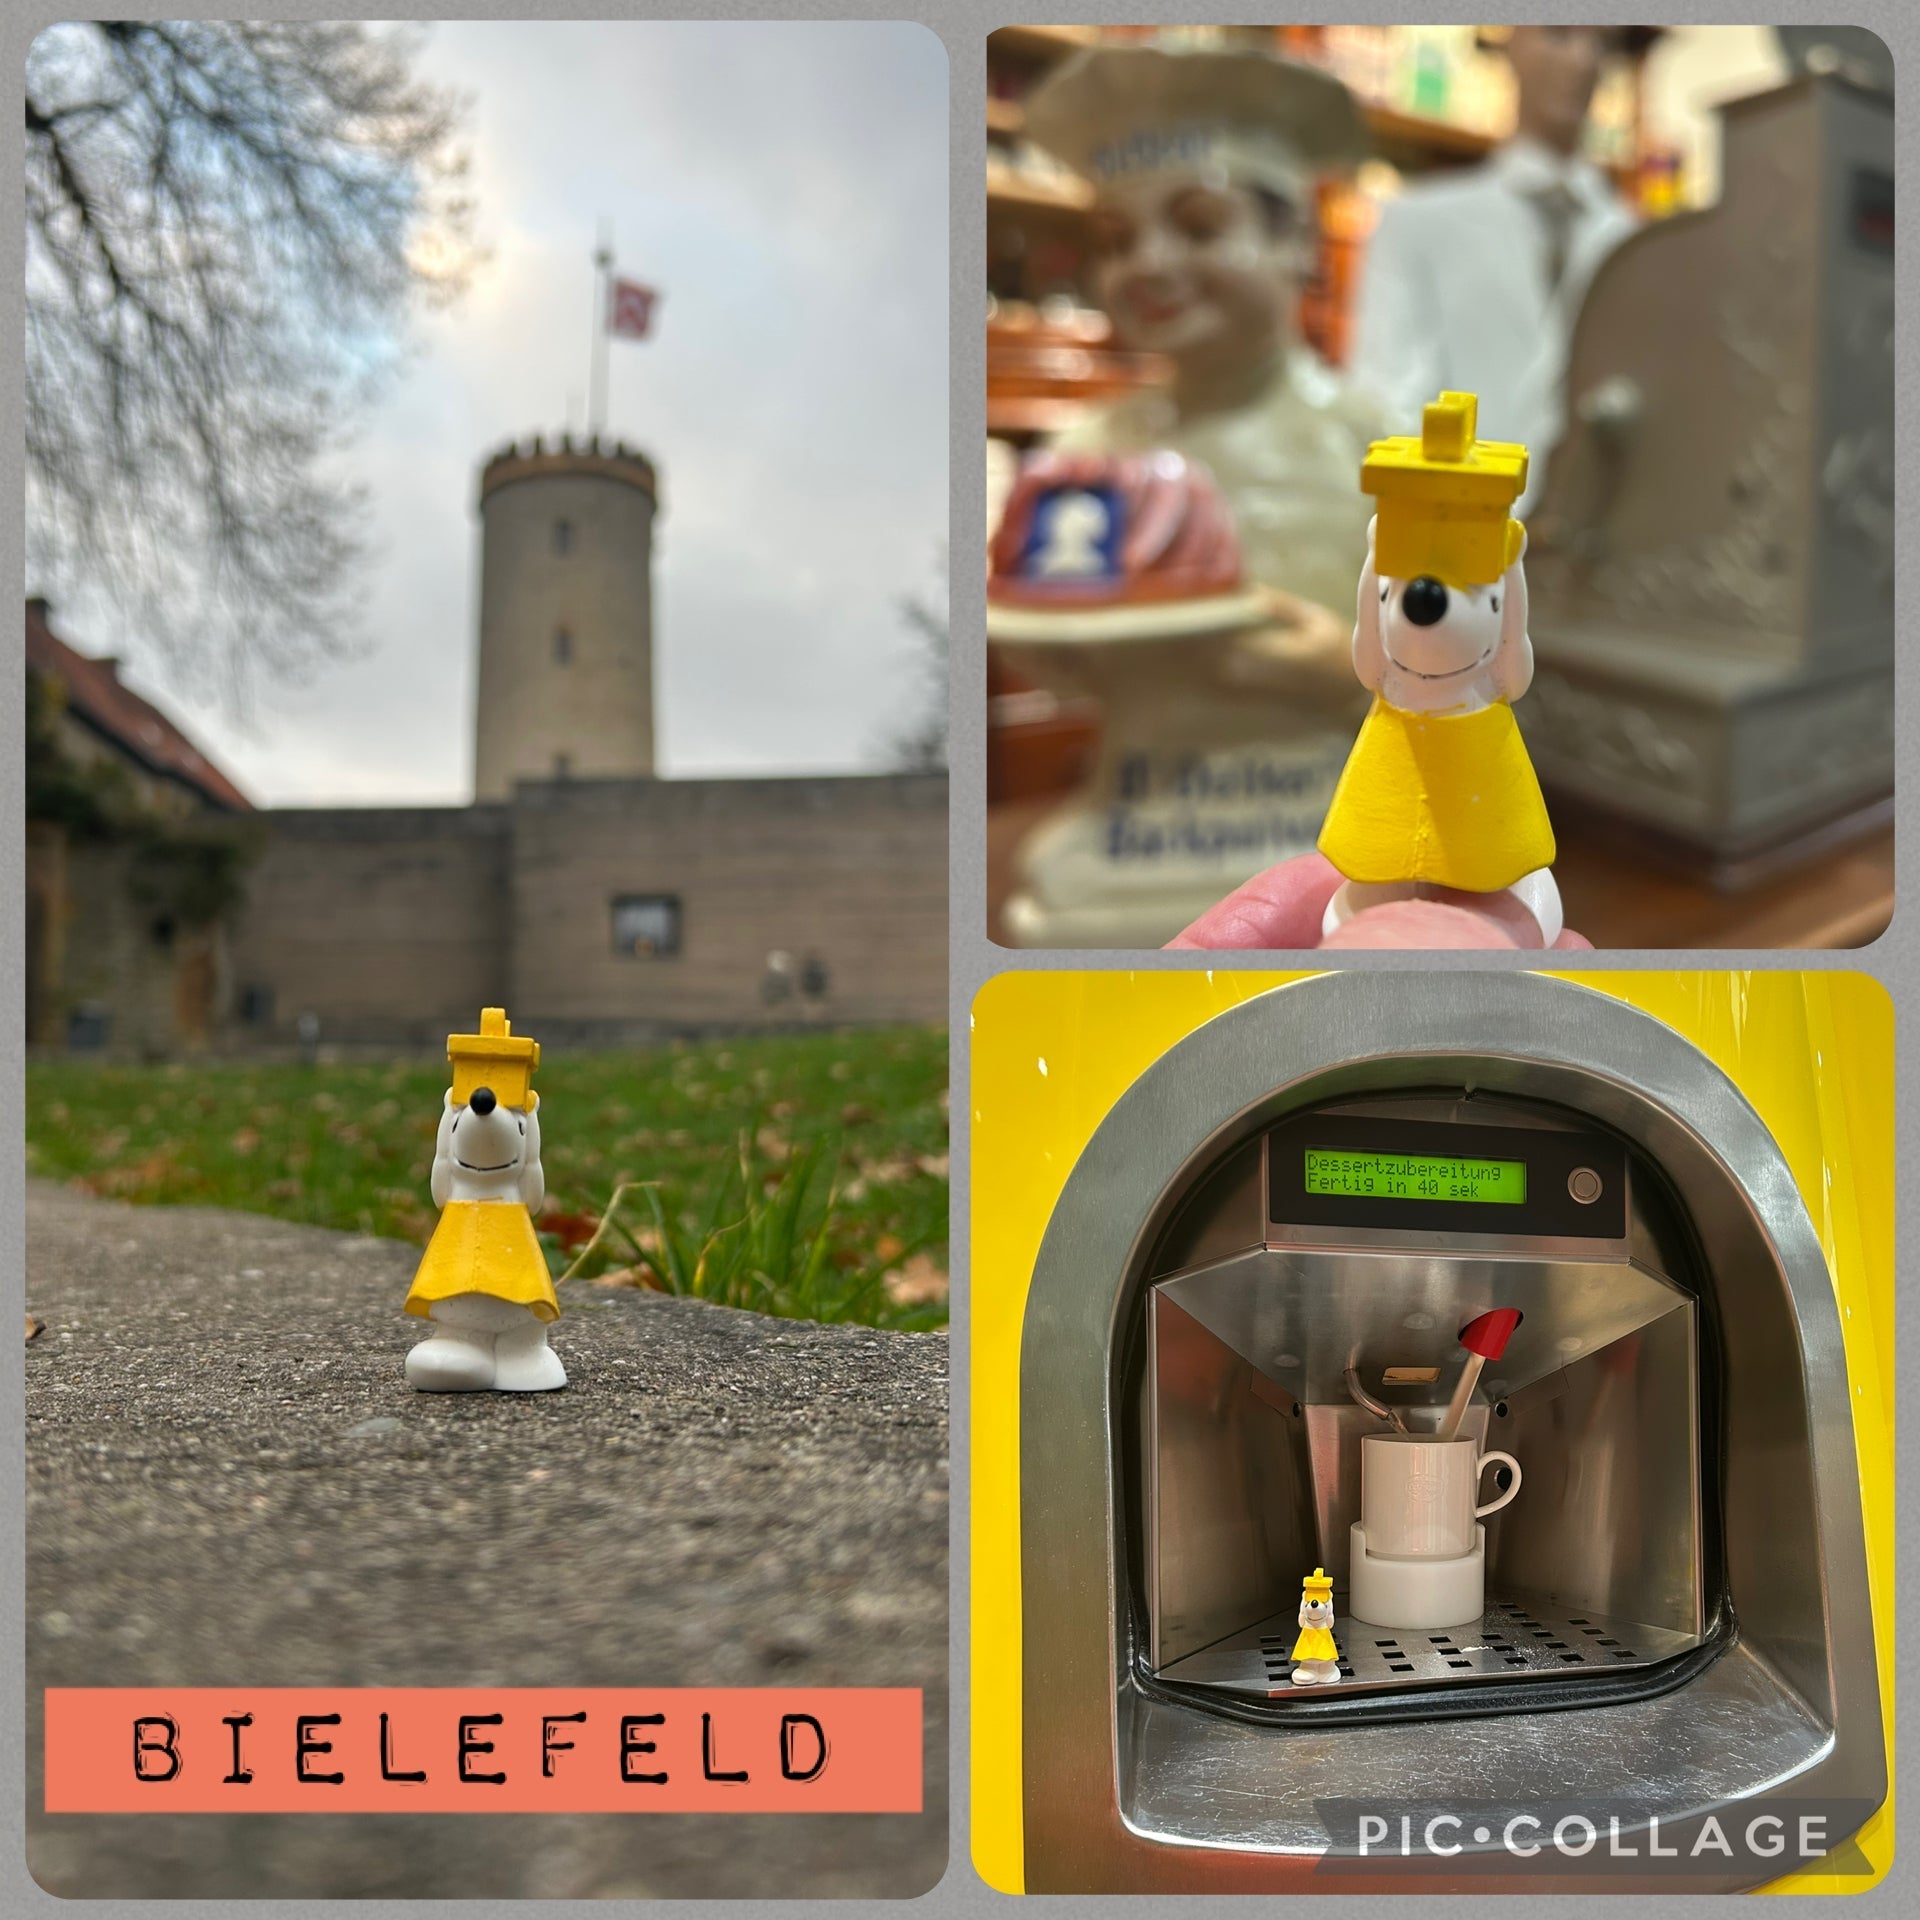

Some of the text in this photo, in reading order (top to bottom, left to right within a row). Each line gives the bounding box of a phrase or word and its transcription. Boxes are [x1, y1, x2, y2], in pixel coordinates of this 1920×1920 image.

[1308, 1154, 1501, 1181] Dessertzubereitung
[1308, 1172, 1479, 1197] Fertig in 40 sek
